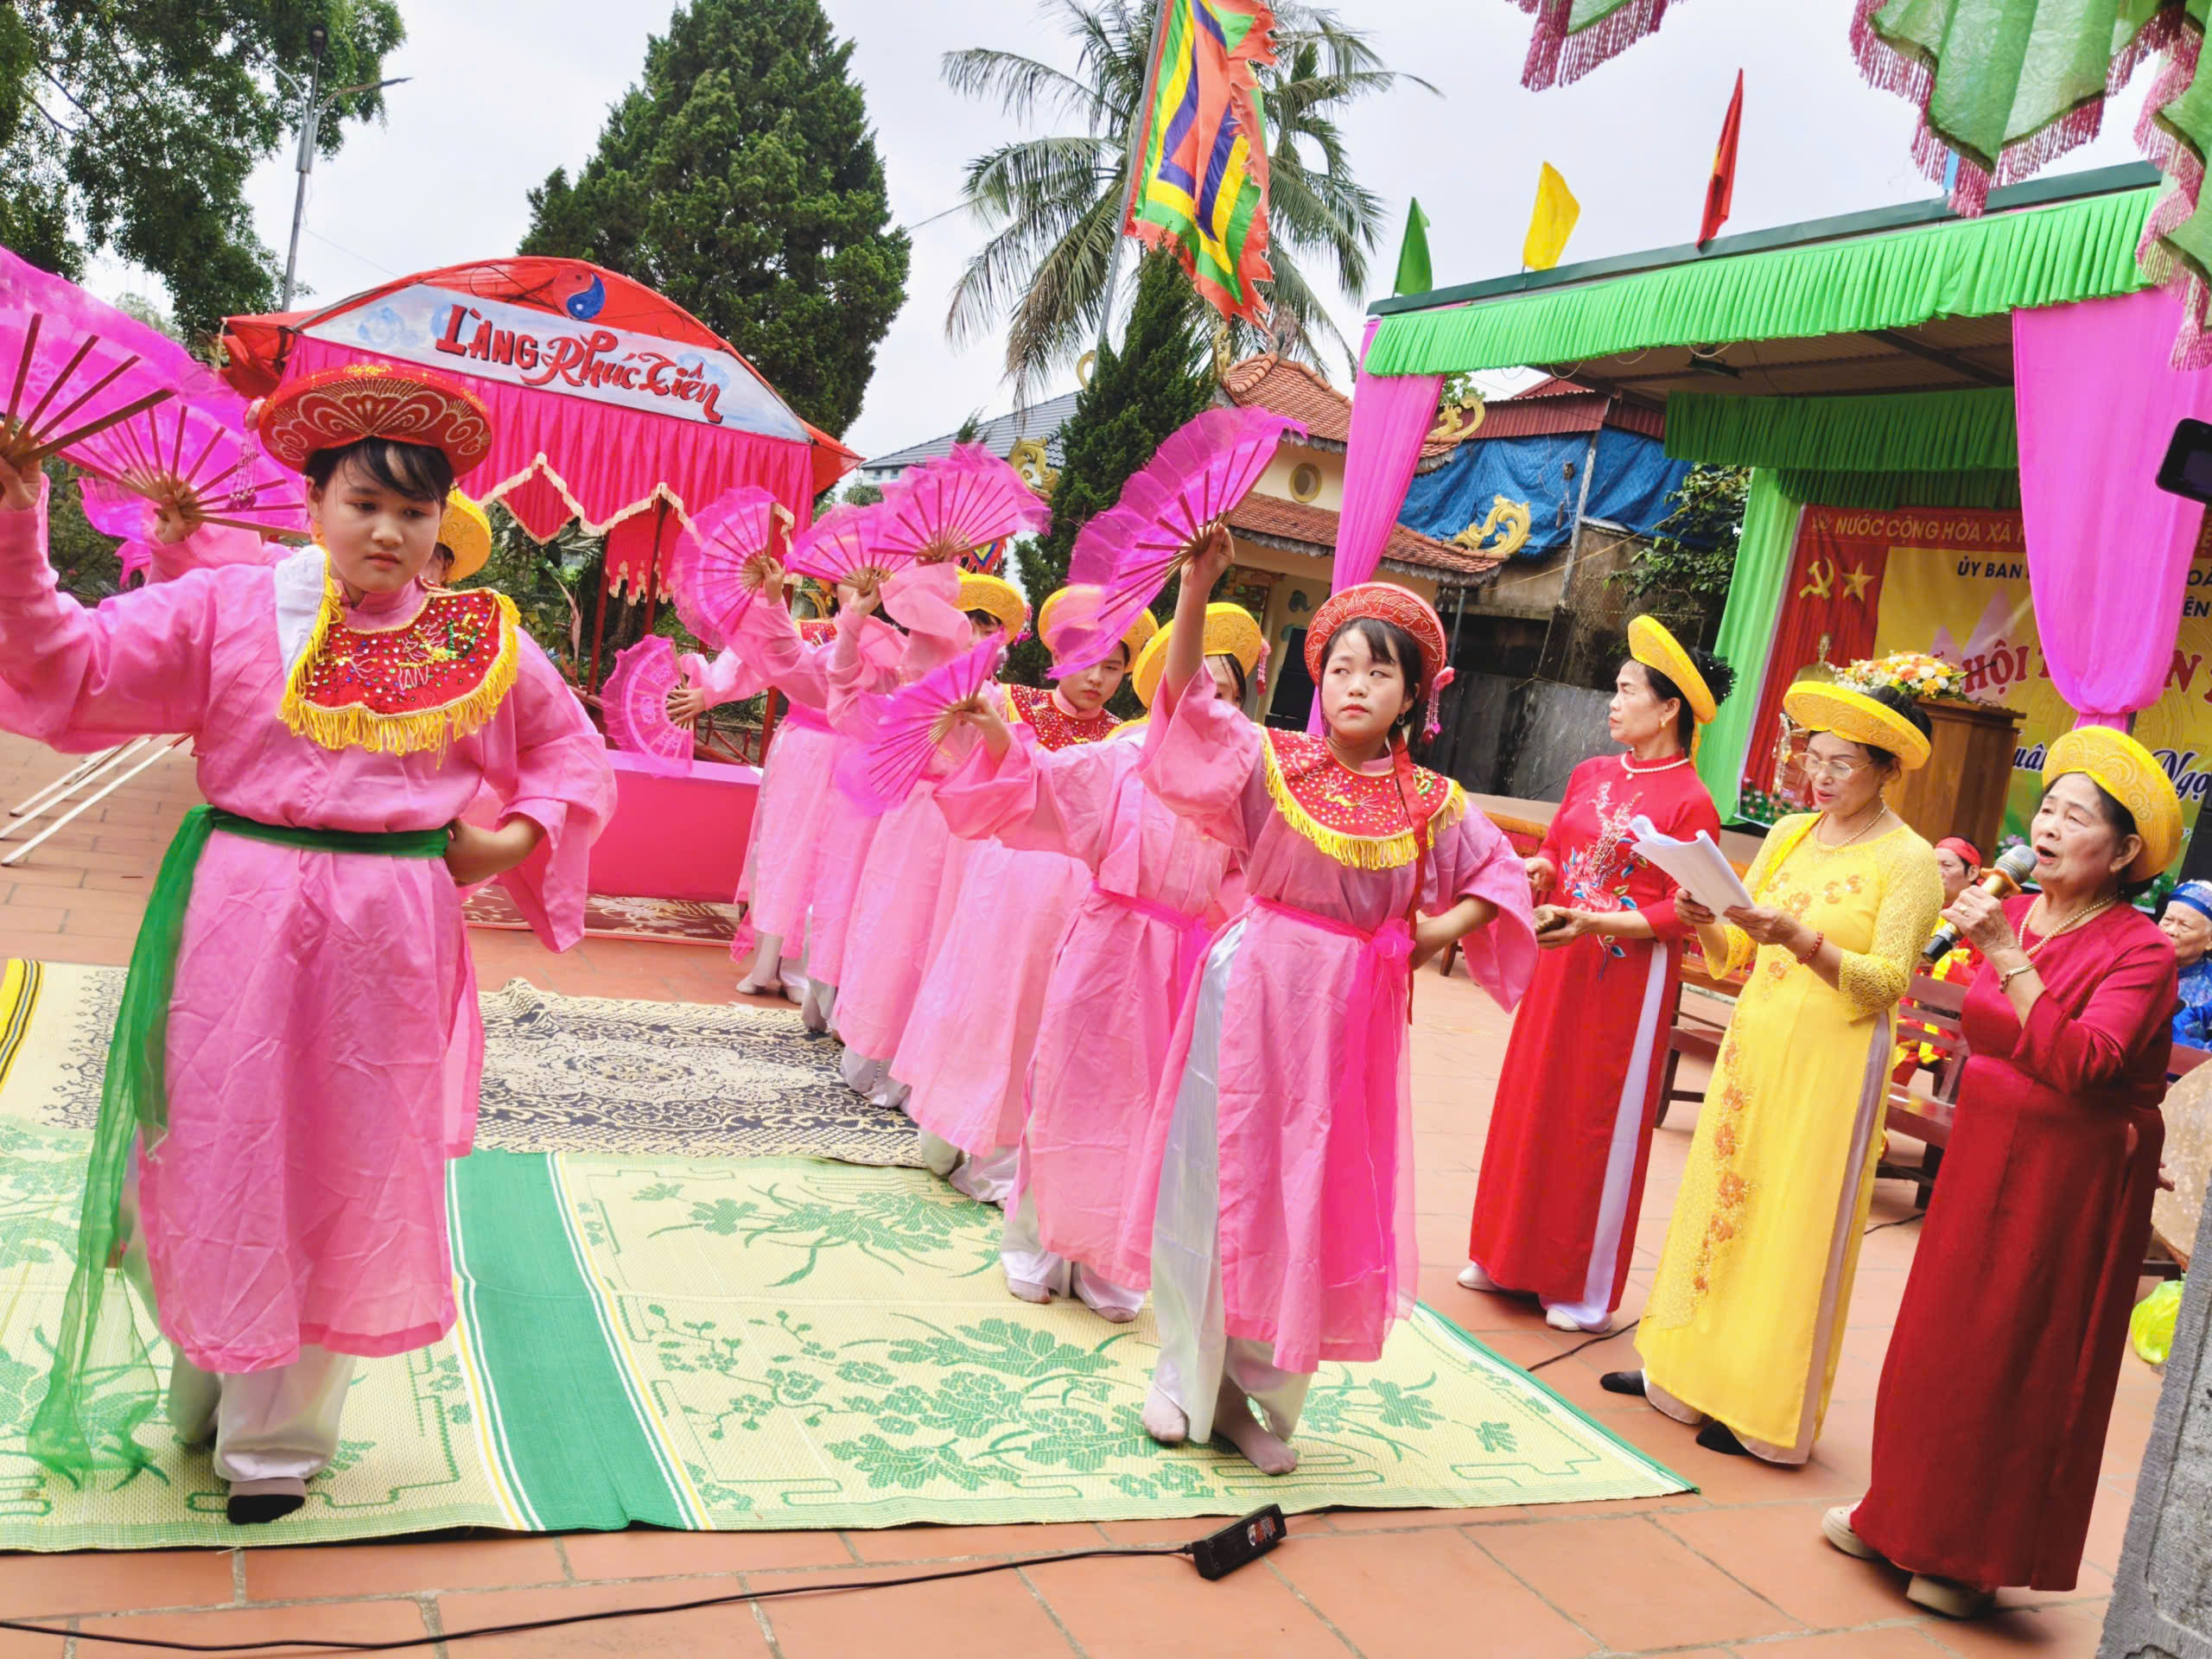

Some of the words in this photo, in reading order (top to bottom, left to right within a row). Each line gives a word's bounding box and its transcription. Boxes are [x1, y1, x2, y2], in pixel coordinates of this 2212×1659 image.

[435, 303, 538, 370] LÀNG
[1835, 512, 1885, 537] NƯỚC
[1886, 515, 1939, 545] CỘNG
[1942, 517, 1981, 542] HÒA
[1986, 518, 2012, 543] XÃ
[1957, 555, 1981, 577] ỦY
[1985, 562, 2023, 579] BAN
[1961, 639, 2030, 695] HỘI
